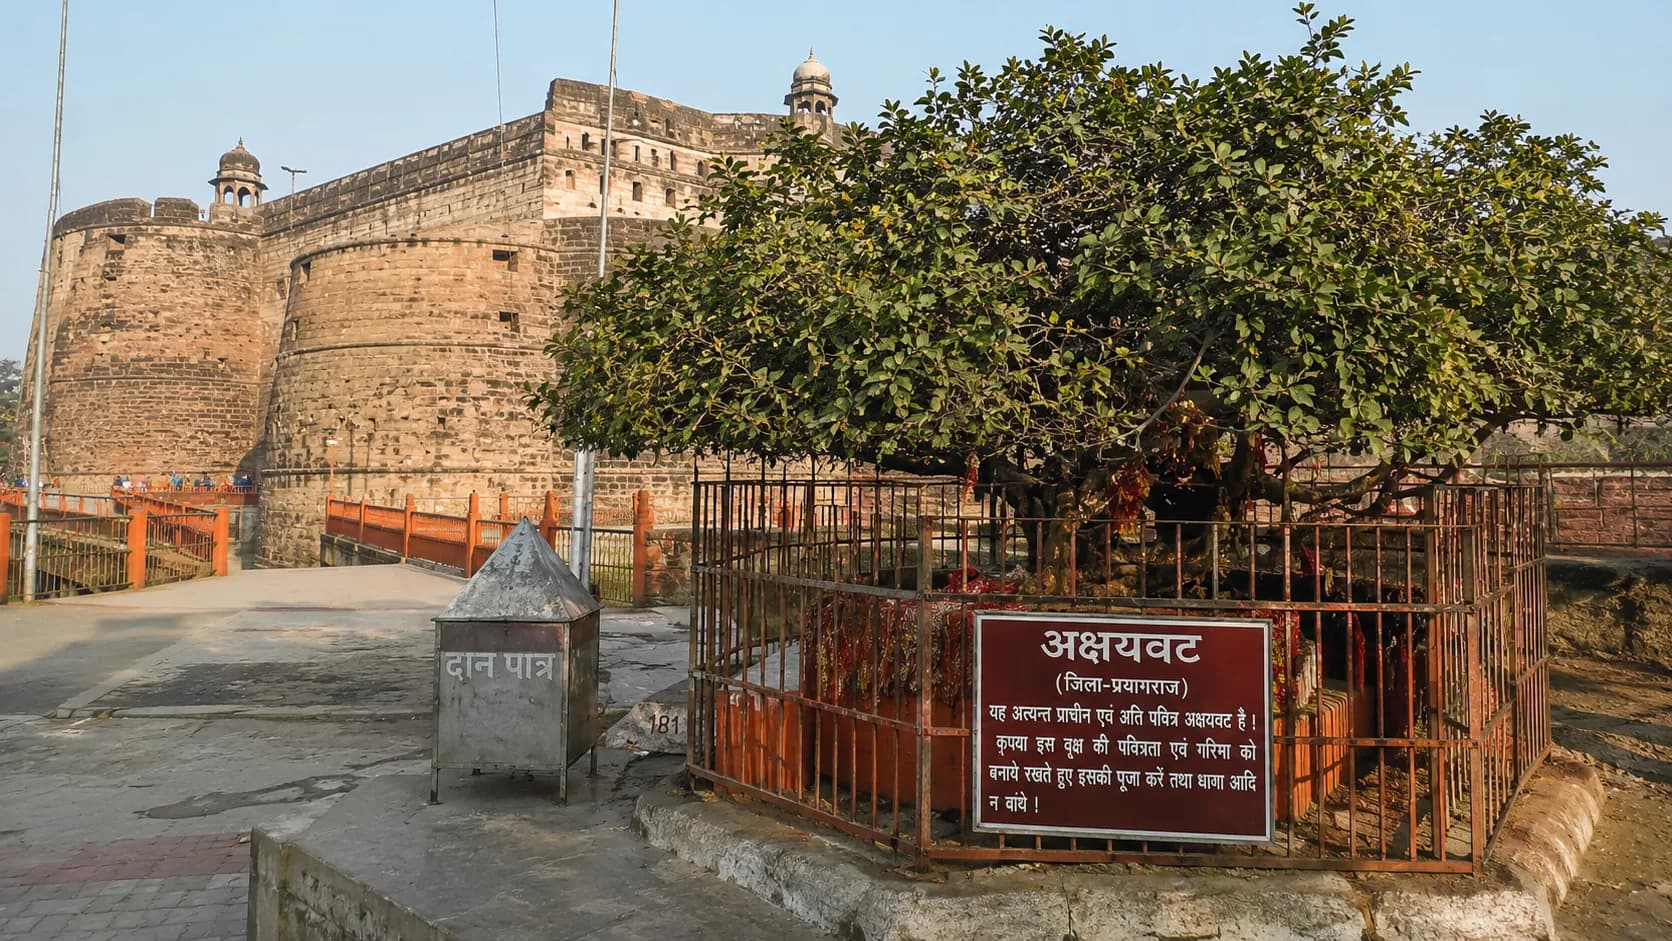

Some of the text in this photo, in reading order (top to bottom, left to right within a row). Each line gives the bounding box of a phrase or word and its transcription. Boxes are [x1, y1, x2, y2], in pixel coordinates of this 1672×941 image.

[1040, 630, 1202, 664] अक्षयवट
[445, 652, 556, 681] दान पात्र
[649, 714, 679, 735] 181
[989, 704, 1007, 722] यह
[1012, 706, 1052, 722] अत्यन्त
[1056, 702, 1091, 724] प्राचीन
[1096, 704, 1114, 727] एवं
[1120, 704, 1144, 726] अति
[1148, 705, 1179, 727] पवित्र
[1184, 712, 1232, 728] अक्षयवट
[1237, 707, 1247, 731] है
[996, 735, 1028, 756] कृपया
[1035, 736, 1055, 755] इस
[1092, 733, 1109, 755] की
[1117, 734, 1161, 757] पवित्रता
[1169, 738, 1188, 760] एवं
[1196, 737, 1231, 760] गरिमा
[1240, 739, 1256, 760] को
[988, 760, 1257, 792] बनाये रखते हुए इसकी पूजा करें तथा धागा आदि
[989, 796, 999, 811] न
